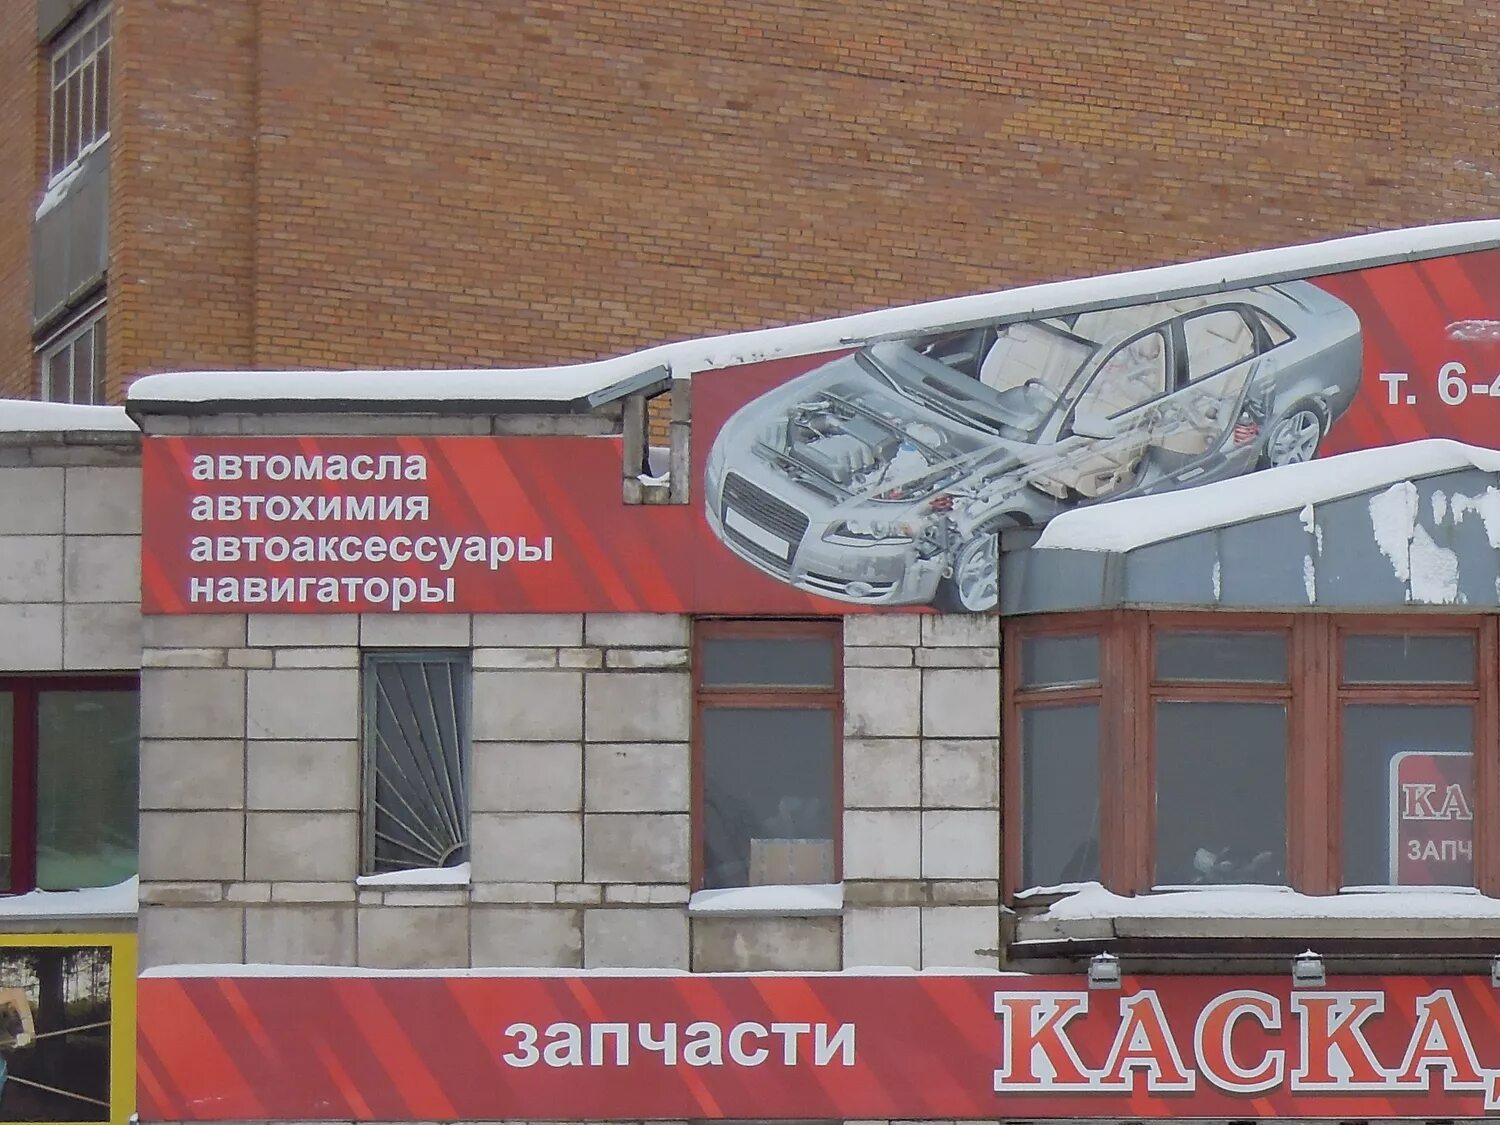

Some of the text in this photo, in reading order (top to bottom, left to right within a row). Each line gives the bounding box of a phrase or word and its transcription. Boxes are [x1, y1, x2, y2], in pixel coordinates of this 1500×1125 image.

[1379, 373, 1416, 405] т.
[192, 454, 427, 481] автомасла
[191, 495, 429, 521] автохимия
[190, 535, 553, 570] автоаксессуары
[190, 576, 455, 611] навигаторы
[503, 1021, 856, 1067] запчасти
